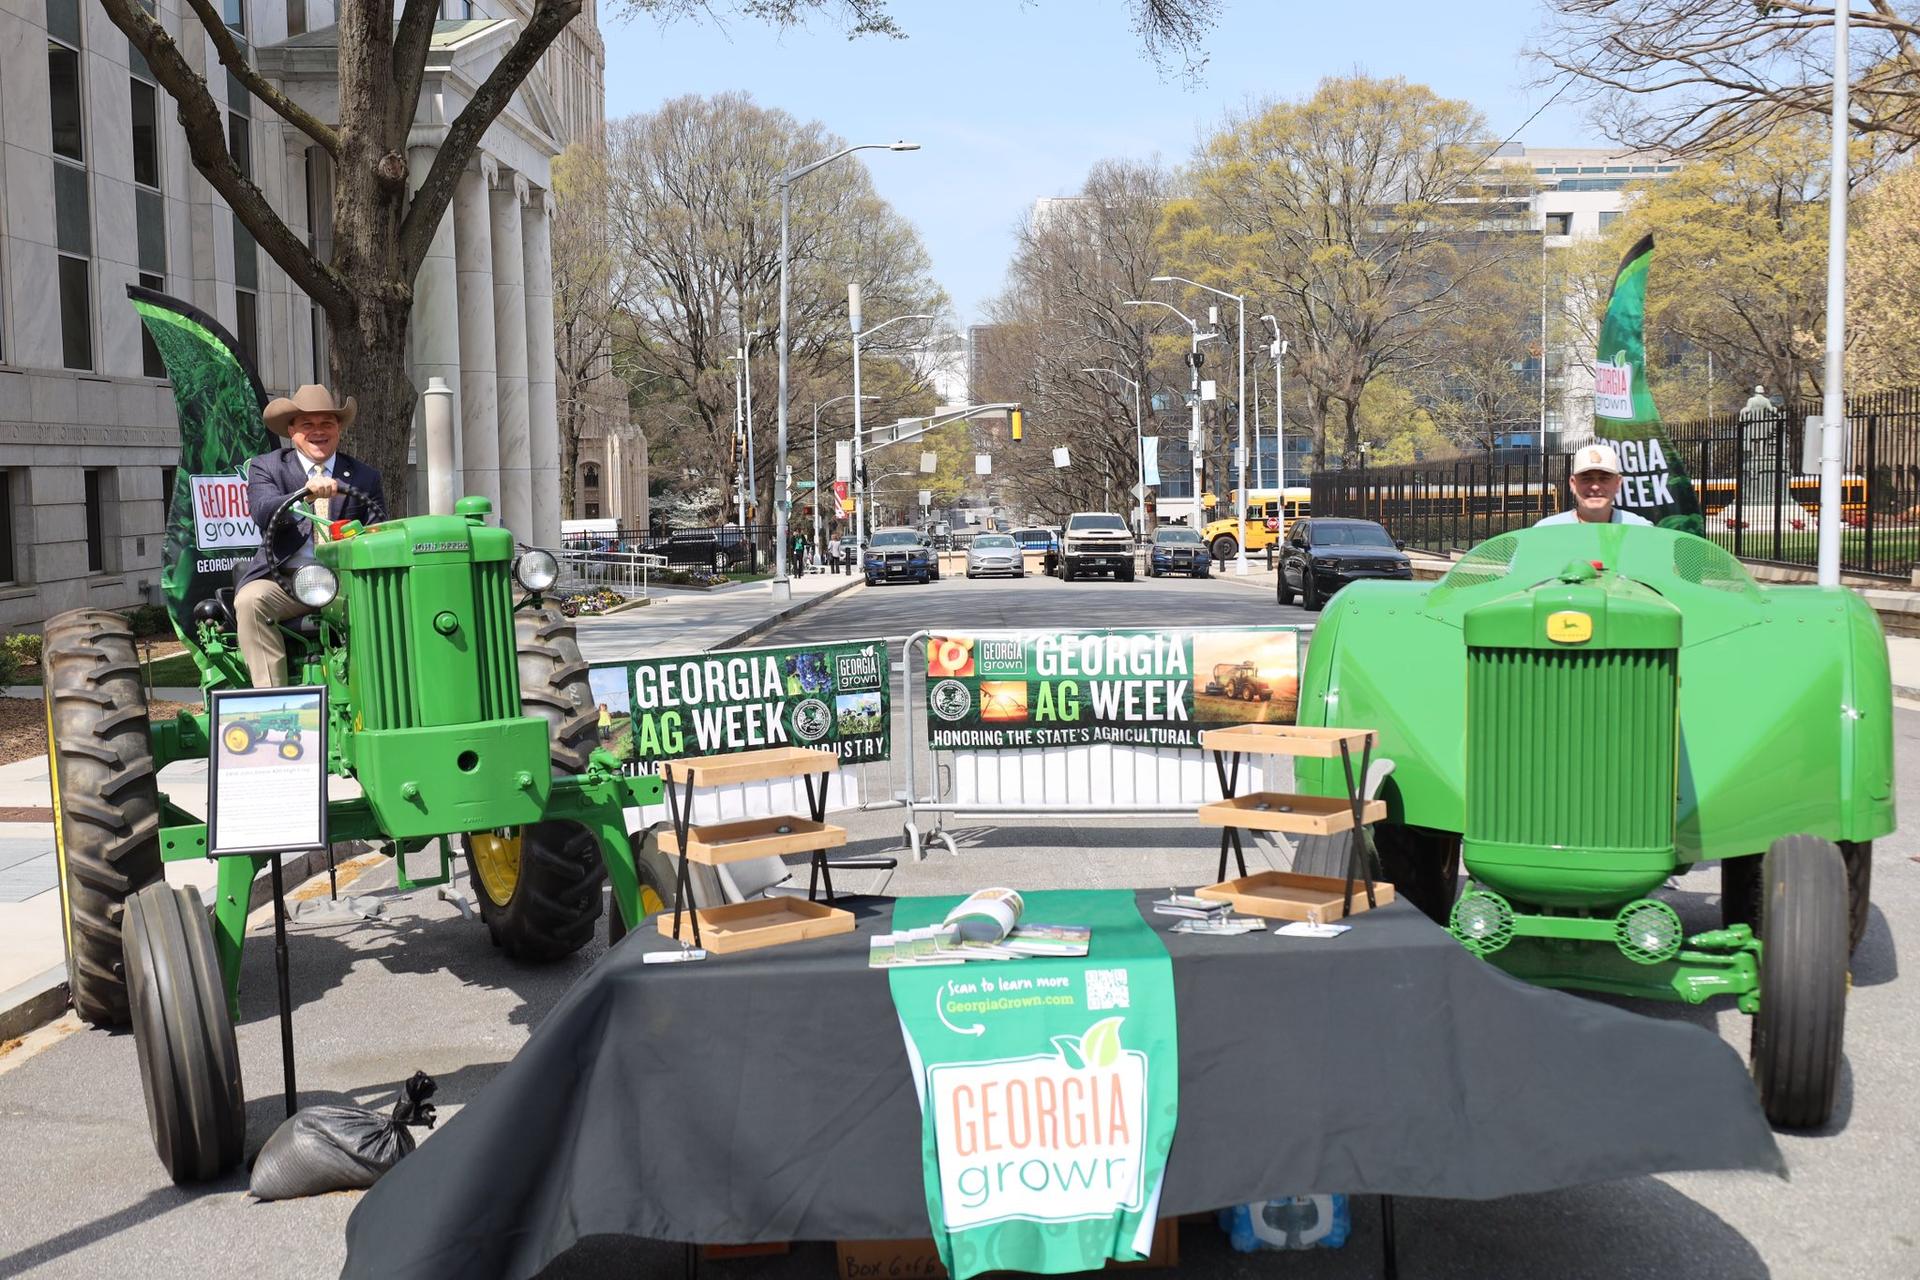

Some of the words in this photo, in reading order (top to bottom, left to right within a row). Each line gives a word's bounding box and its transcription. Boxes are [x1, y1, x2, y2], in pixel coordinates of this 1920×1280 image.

[204, 521, 256, 542] grow
[983, 642, 1023, 661] GEORGIA
[1035, 634, 1188, 676] GEORGIA
[840, 657, 877, 676] GEORGIA
[983, 660, 1023, 671] grown
[635, 656, 784, 709] GEORGIA
[841, 675, 878, 687] grown
[1035, 680, 1080, 721] AG
[1089, 680, 1189, 721] WEEK
[640, 711, 684, 756] AG
[691, 701, 788, 751] WEEK
[933, 730, 1003, 746] HONORING
[1006, 729, 1033, 745] THE
[1036, 728, 1090, 744] STATE'S
[1093, 726, 1194, 745] AGRICULTURAL
[948, 979, 978, 997] Scan
[981, 976, 995, 993] to
[998, 976, 1033, 992] learn
[1036, 976, 1070, 988] more
[946, 995, 1075, 1013] GeorgiaGrown.com
[953, 1073, 1130, 1157] GEORGIA
[846, 1256, 882, 1278] Box
